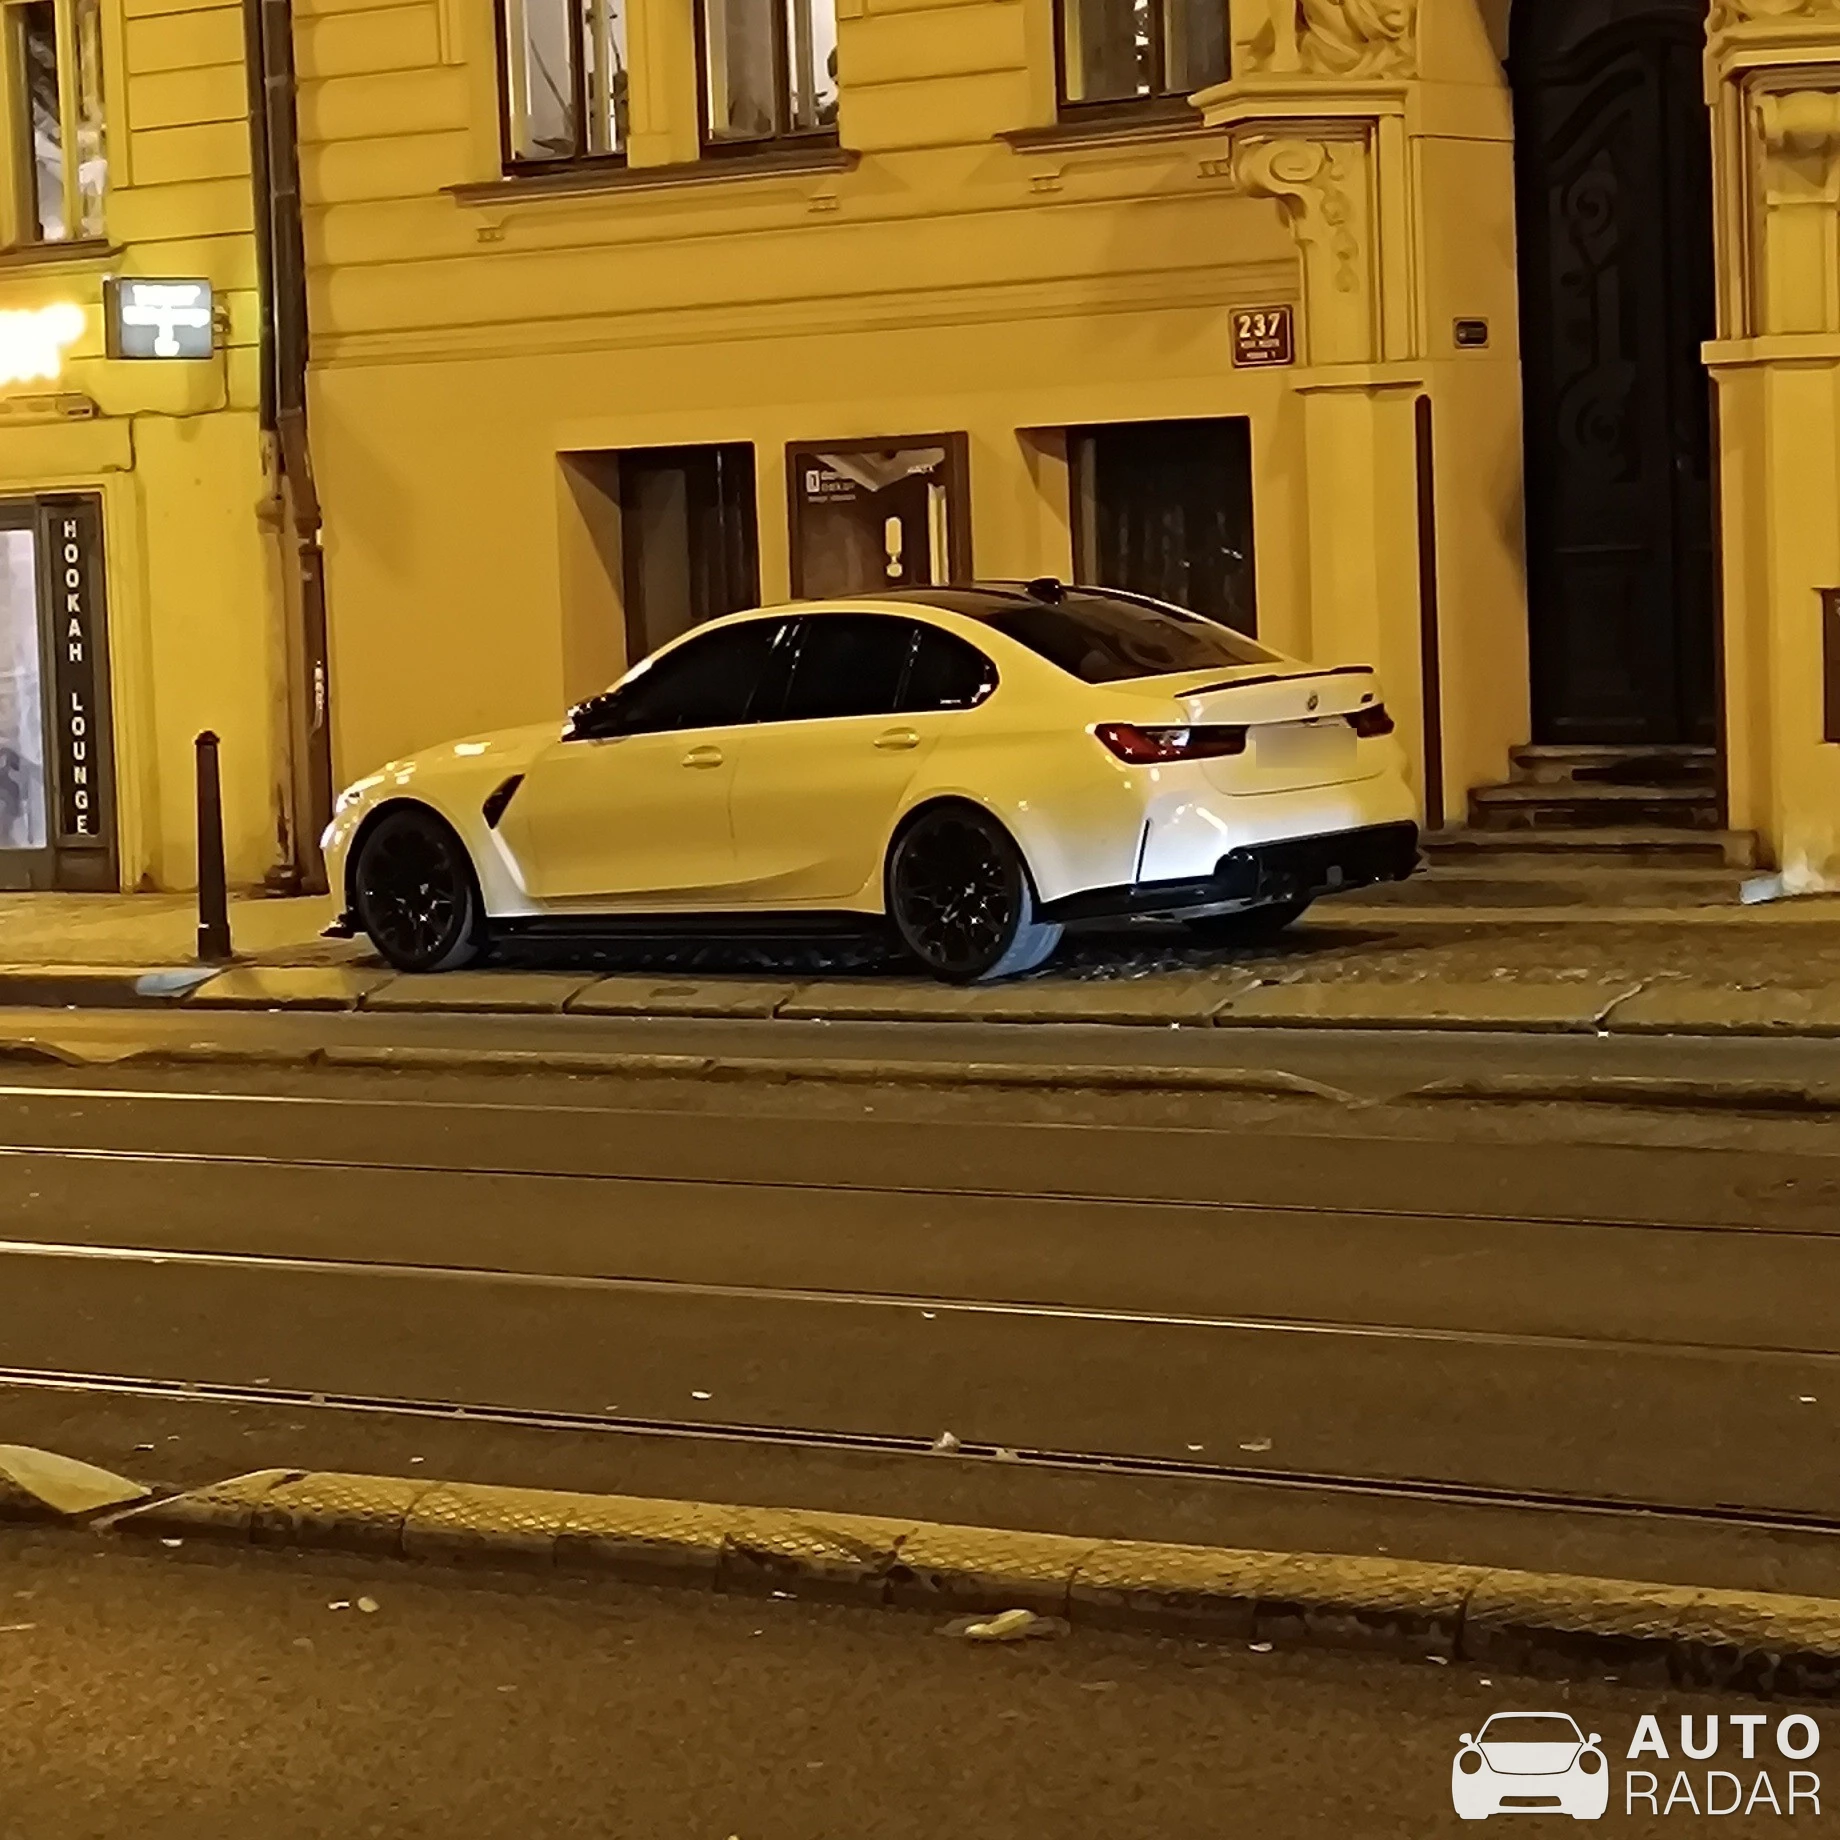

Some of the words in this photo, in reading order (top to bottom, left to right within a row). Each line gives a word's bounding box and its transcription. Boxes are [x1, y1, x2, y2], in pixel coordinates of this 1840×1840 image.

[1239, 312, 1280, 338] 237
[63, 519, 83, 662] HOOKAH
[71, 692, 89, 834] LOUNGE
